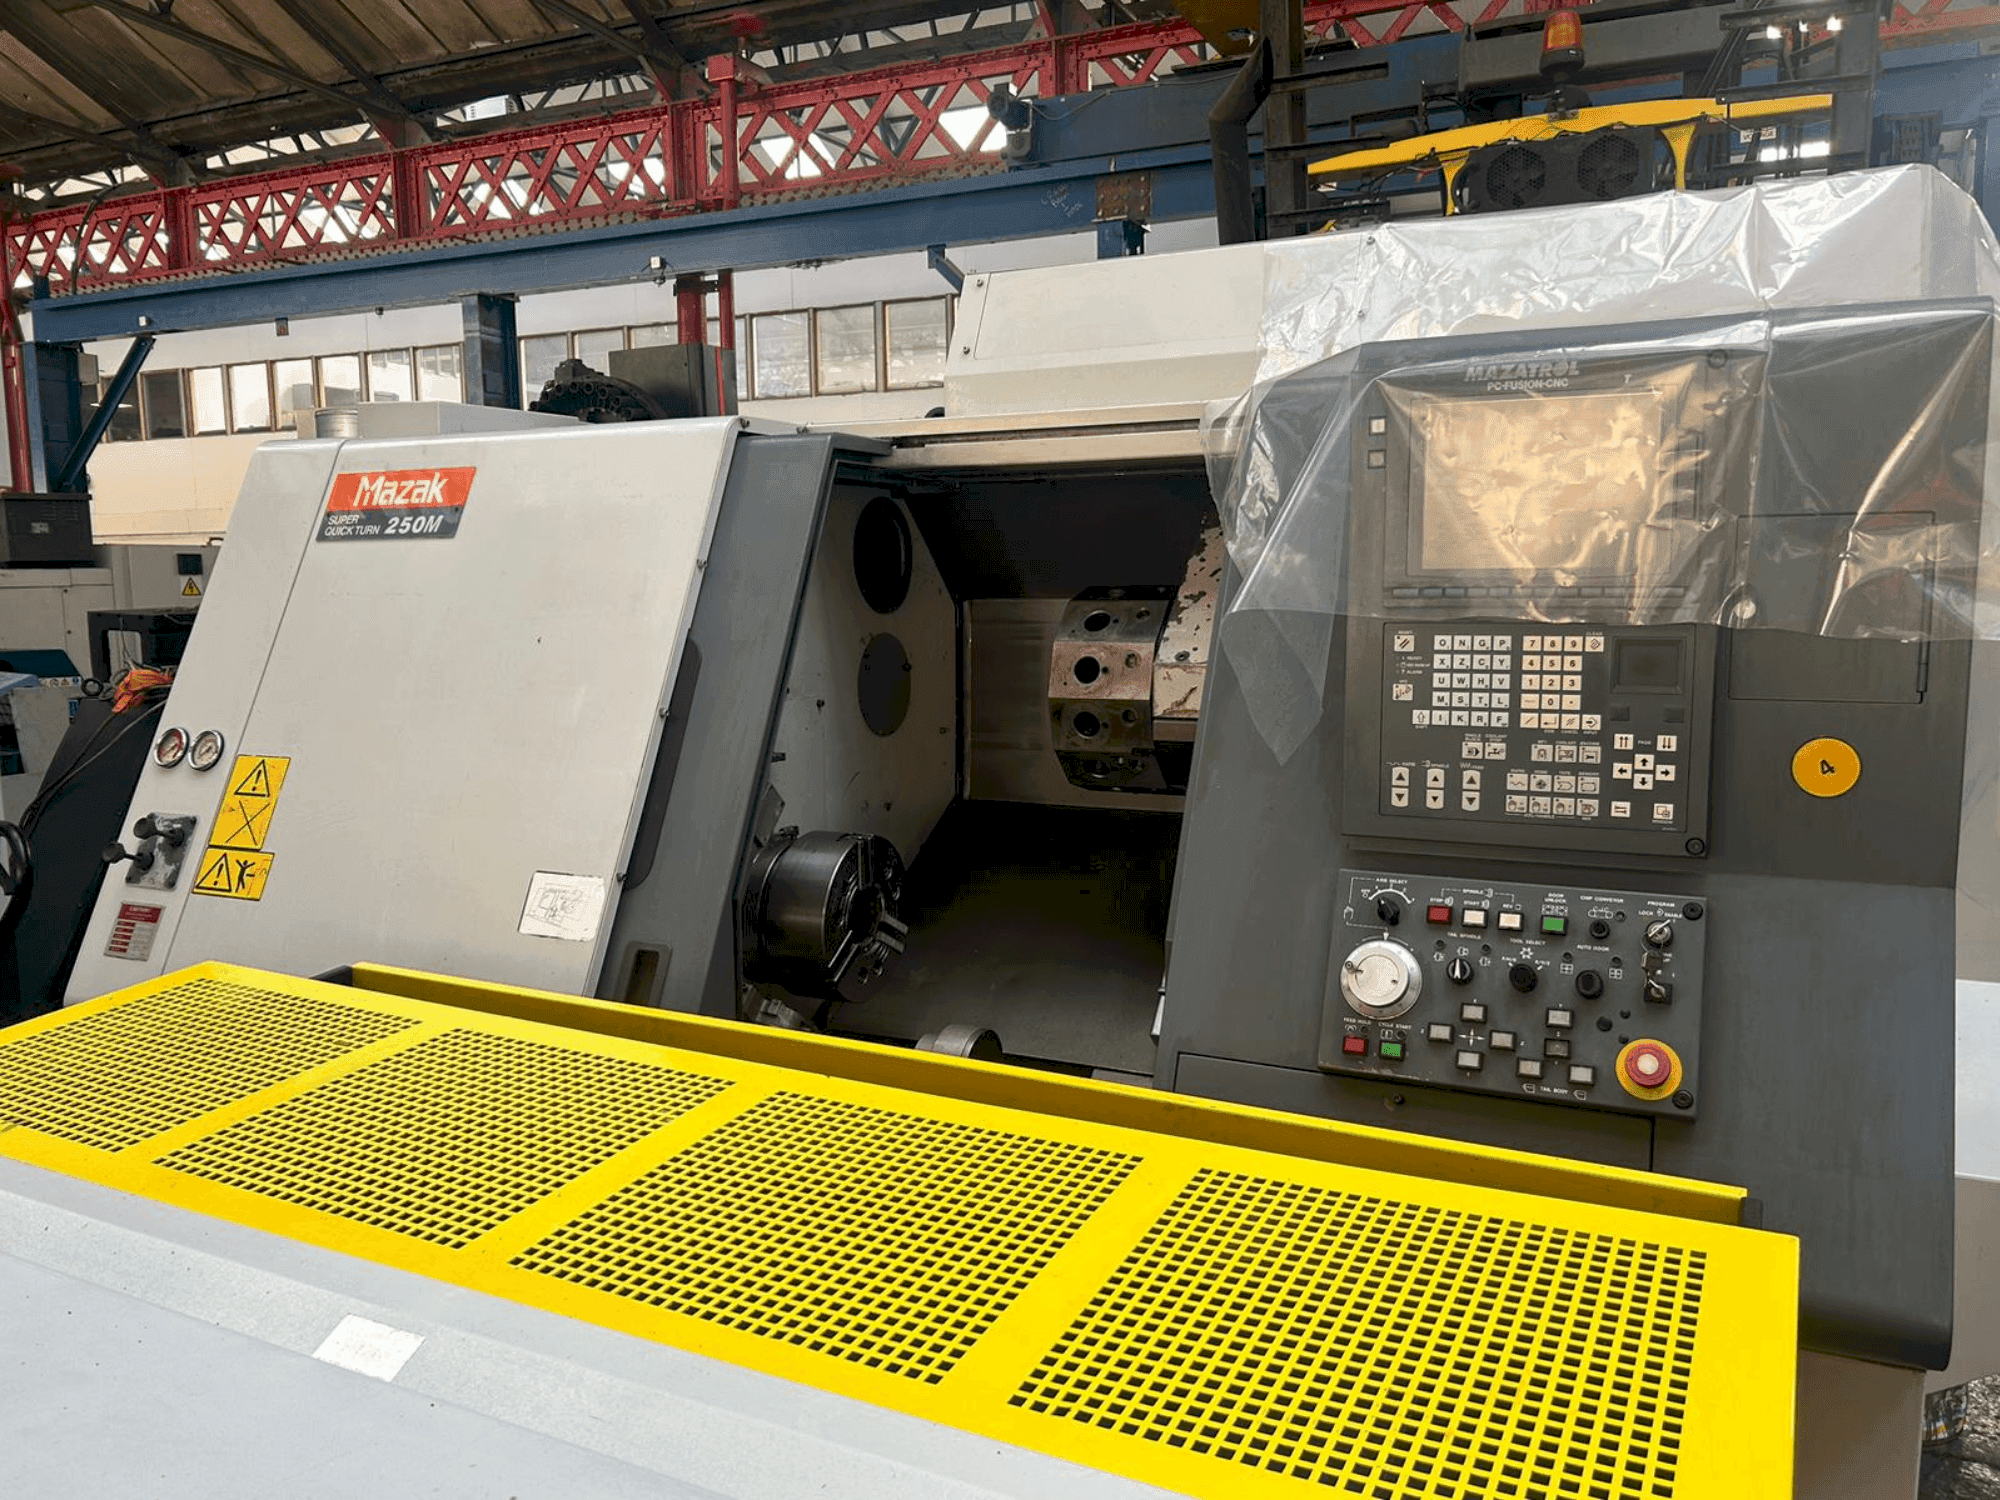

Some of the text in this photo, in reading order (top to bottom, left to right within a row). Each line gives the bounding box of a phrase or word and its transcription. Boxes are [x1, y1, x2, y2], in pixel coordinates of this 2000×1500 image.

[1464, 360, 1580, 382] MAZATROL
[1487, 378, 1569, 391] PC-FUSION-CNC
[352, 471, 449, 507] Mazak
[328, 514, 360, 526] SUPER
[384, 514, 444, 535] 250M
[324, 524, 381, 536] QUICK TURN
[1550, 640, 1556, 648] 8
[1570, 640, 1577, 648] 9
[1439, 658, 1446, 666] X
[1459, 658, 1466, 666] Z
[1478, 658, 1485, 666] C
[1498, 658, 1505, 666] Y
[1569, 660, 1576, 668] 6
[1498, 678, 1504, 686] V
[1528, 678, 1533, 686] 1
[1568, 679, 1575, 687] 3
[1478, 696, 1484, 704] T
[1438, 714, 1442, 722] I
[1820, 759, 1835, 774] 4
[1647, 900, 1675, 908] PROGRAM
